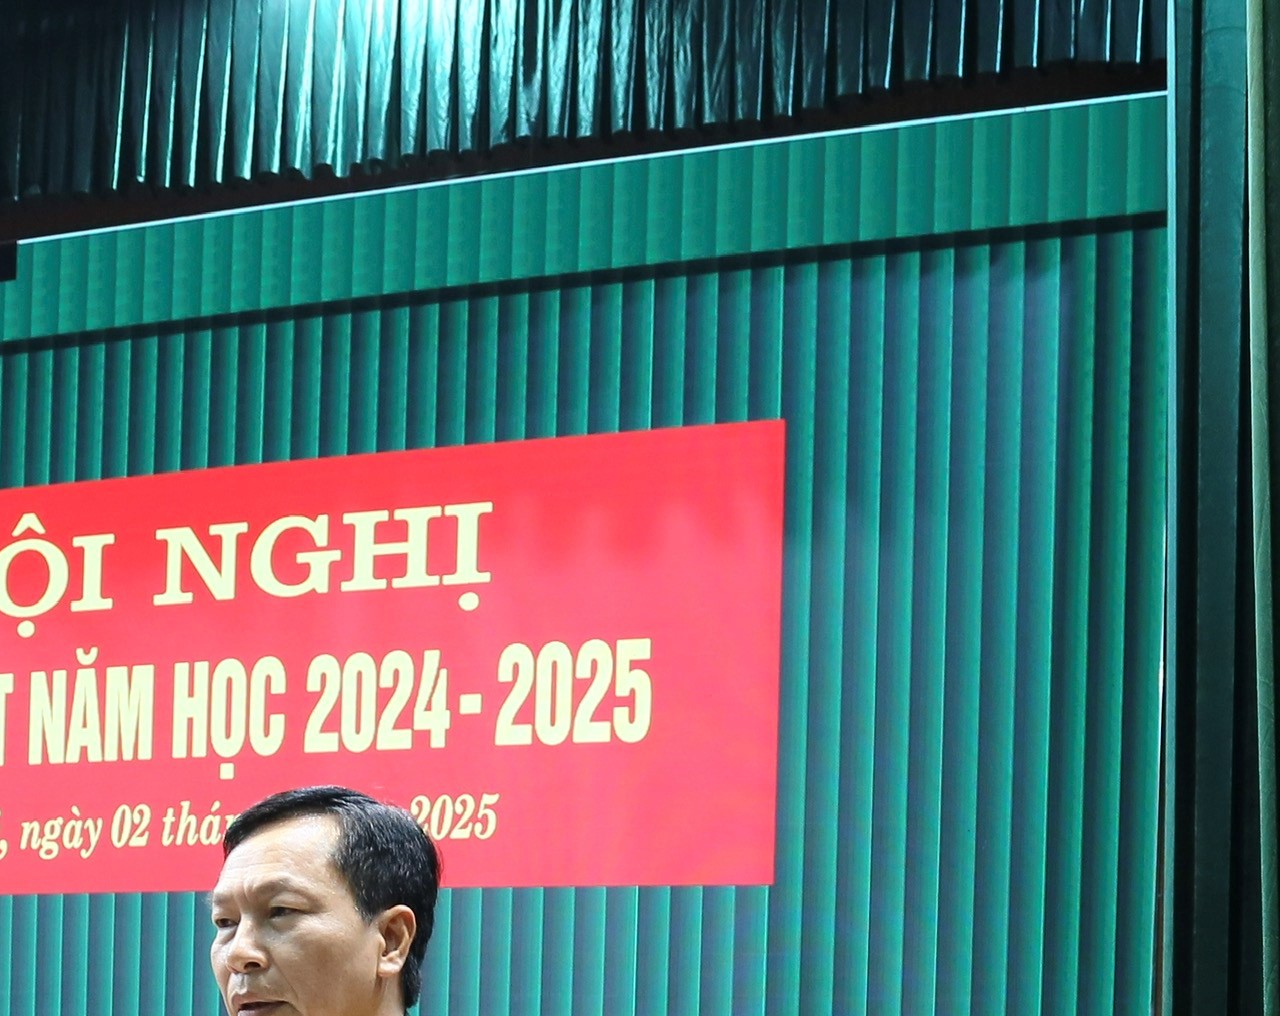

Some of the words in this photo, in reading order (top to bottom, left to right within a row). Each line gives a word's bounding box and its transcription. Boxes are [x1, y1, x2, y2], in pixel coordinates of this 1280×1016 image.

[152, 501, 494, 612] NGHỊ
[27, 646, 156, 766] NĂM
[171, 655, 287, 781] HỌC
[19, 803, 104, 861] ngày
[110, 800, 152, 849] 02
[410, 793, 501, 841] 2025
